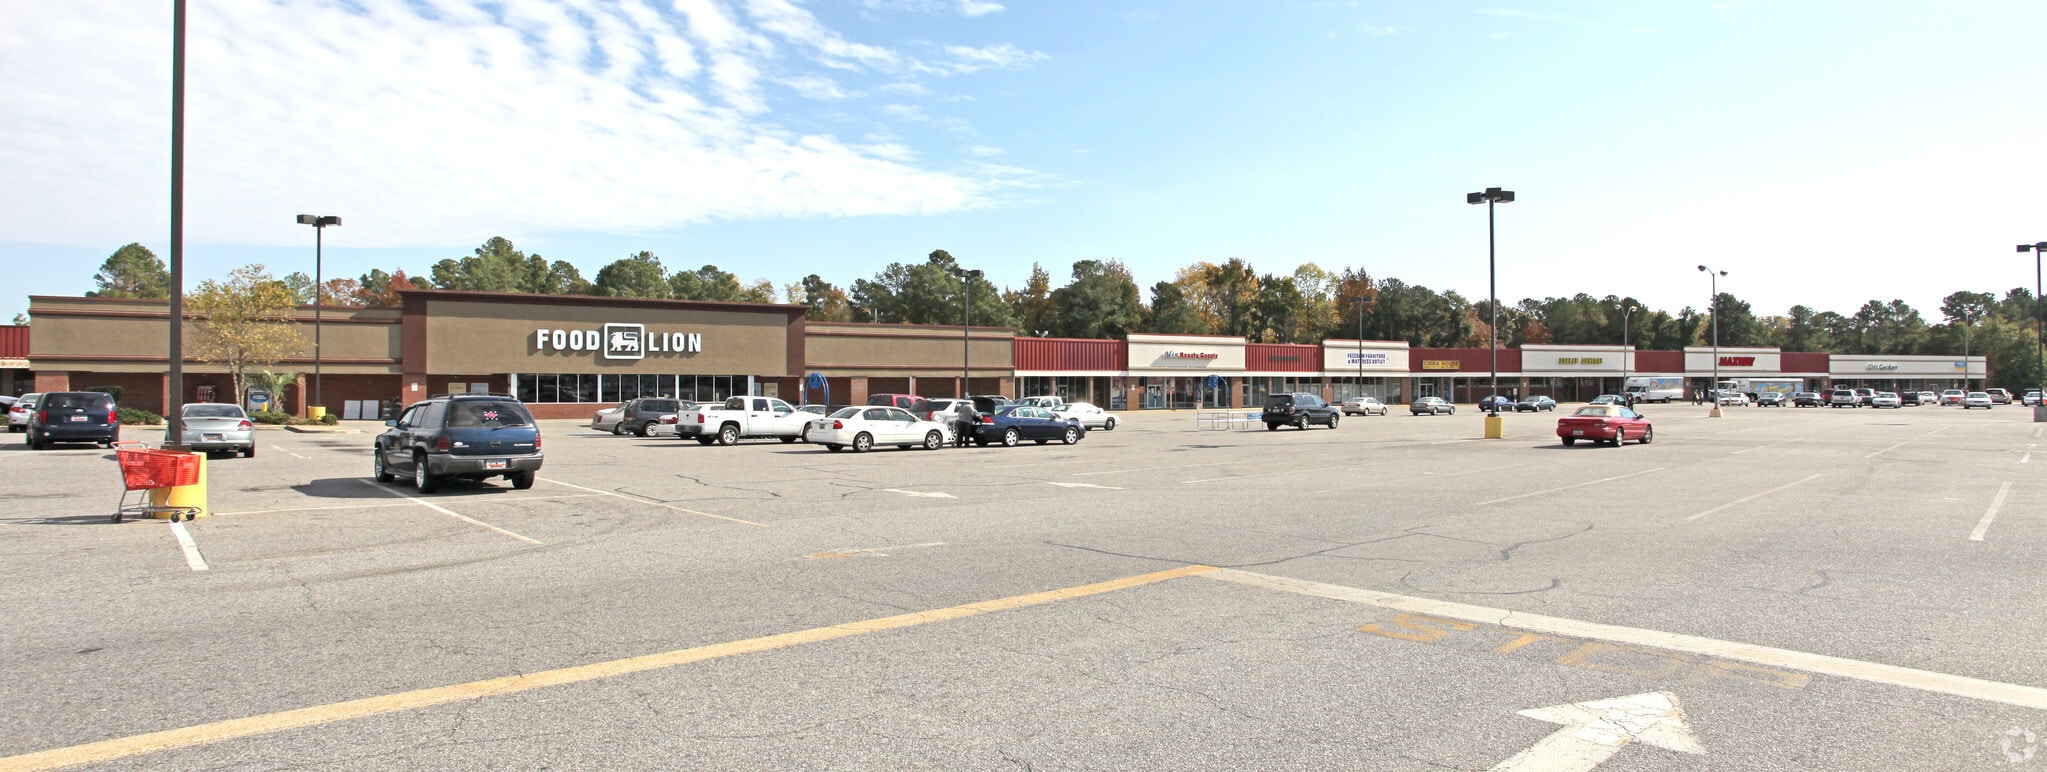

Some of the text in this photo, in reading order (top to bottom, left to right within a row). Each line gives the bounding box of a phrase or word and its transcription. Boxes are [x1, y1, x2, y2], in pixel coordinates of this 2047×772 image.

[536, 329, 701, 352] FOOD LION
[1718, 357, 1755, 366] MAXWAY
[1356, 612, 1810, 689] STOP
